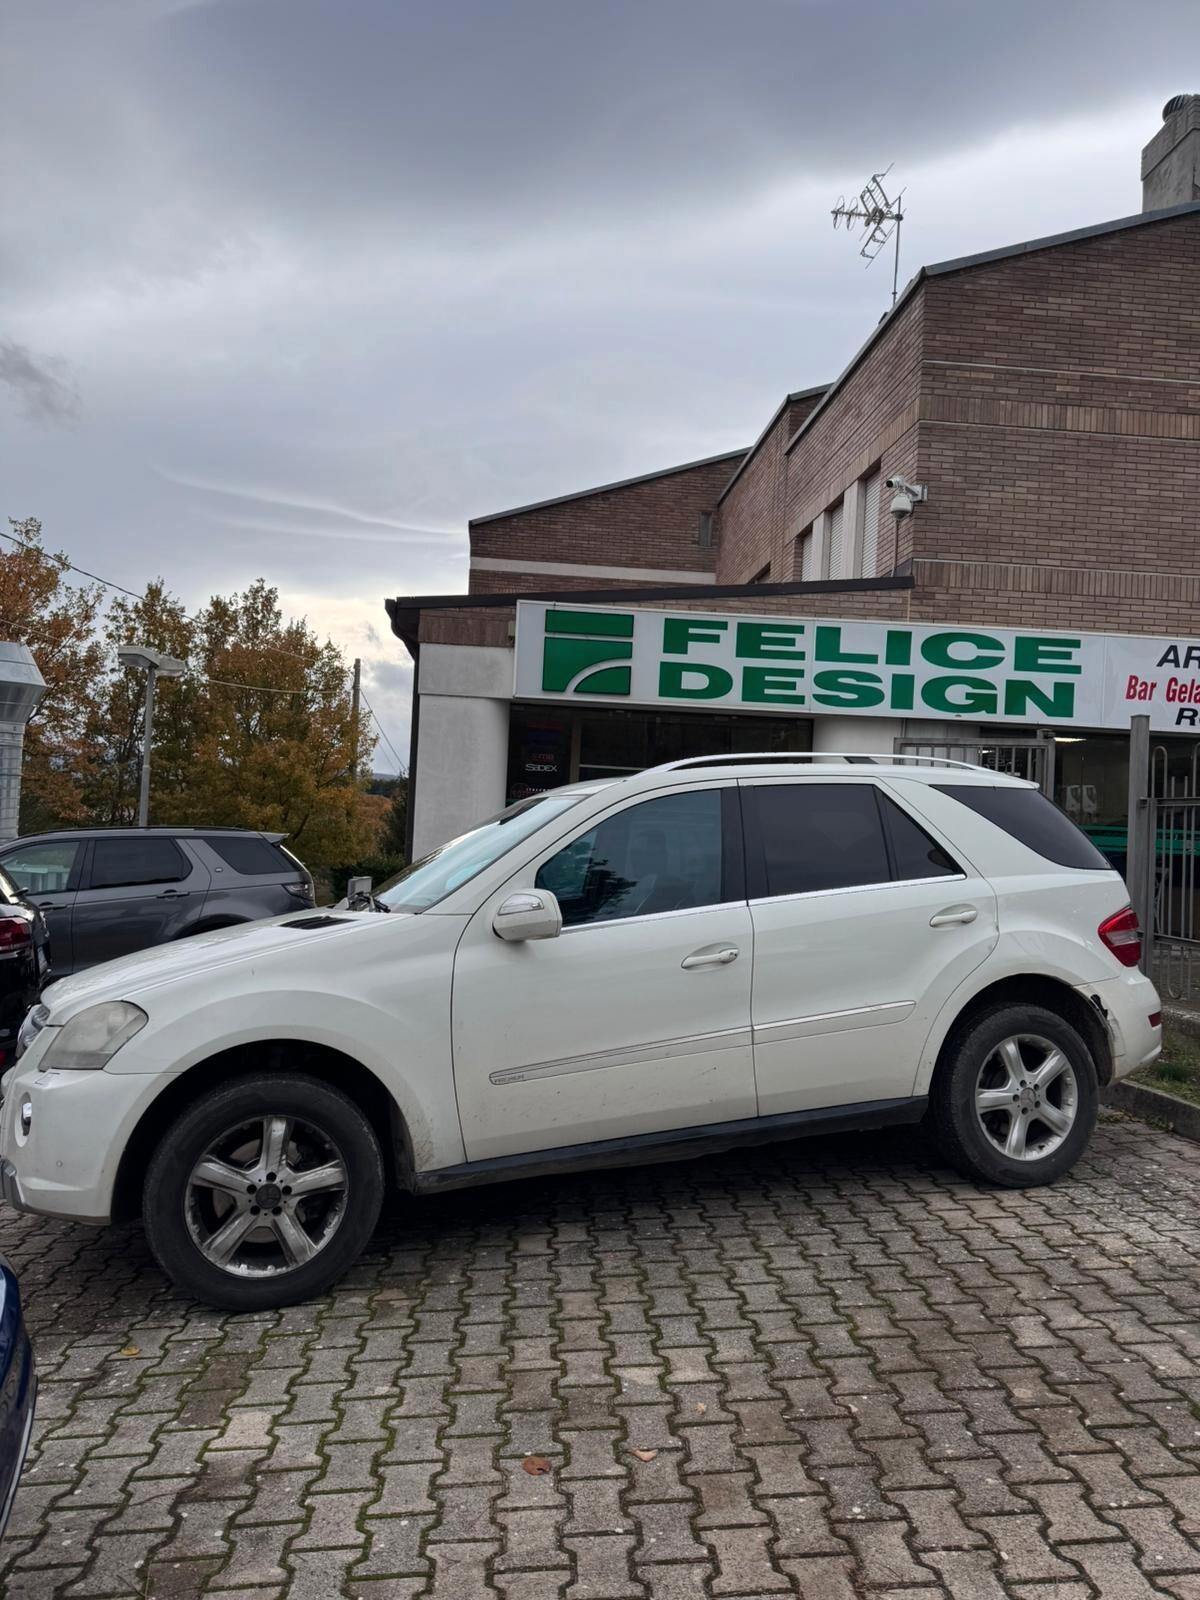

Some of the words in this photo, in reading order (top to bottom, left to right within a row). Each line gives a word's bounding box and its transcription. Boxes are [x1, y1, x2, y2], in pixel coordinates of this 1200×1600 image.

[662, 618, 1083, 677] FELICE
[657, 660, 1075, 719] DESIGN
[1125, 674, 1157, 701] Bar
[1174, 707, 1200, 727] R
